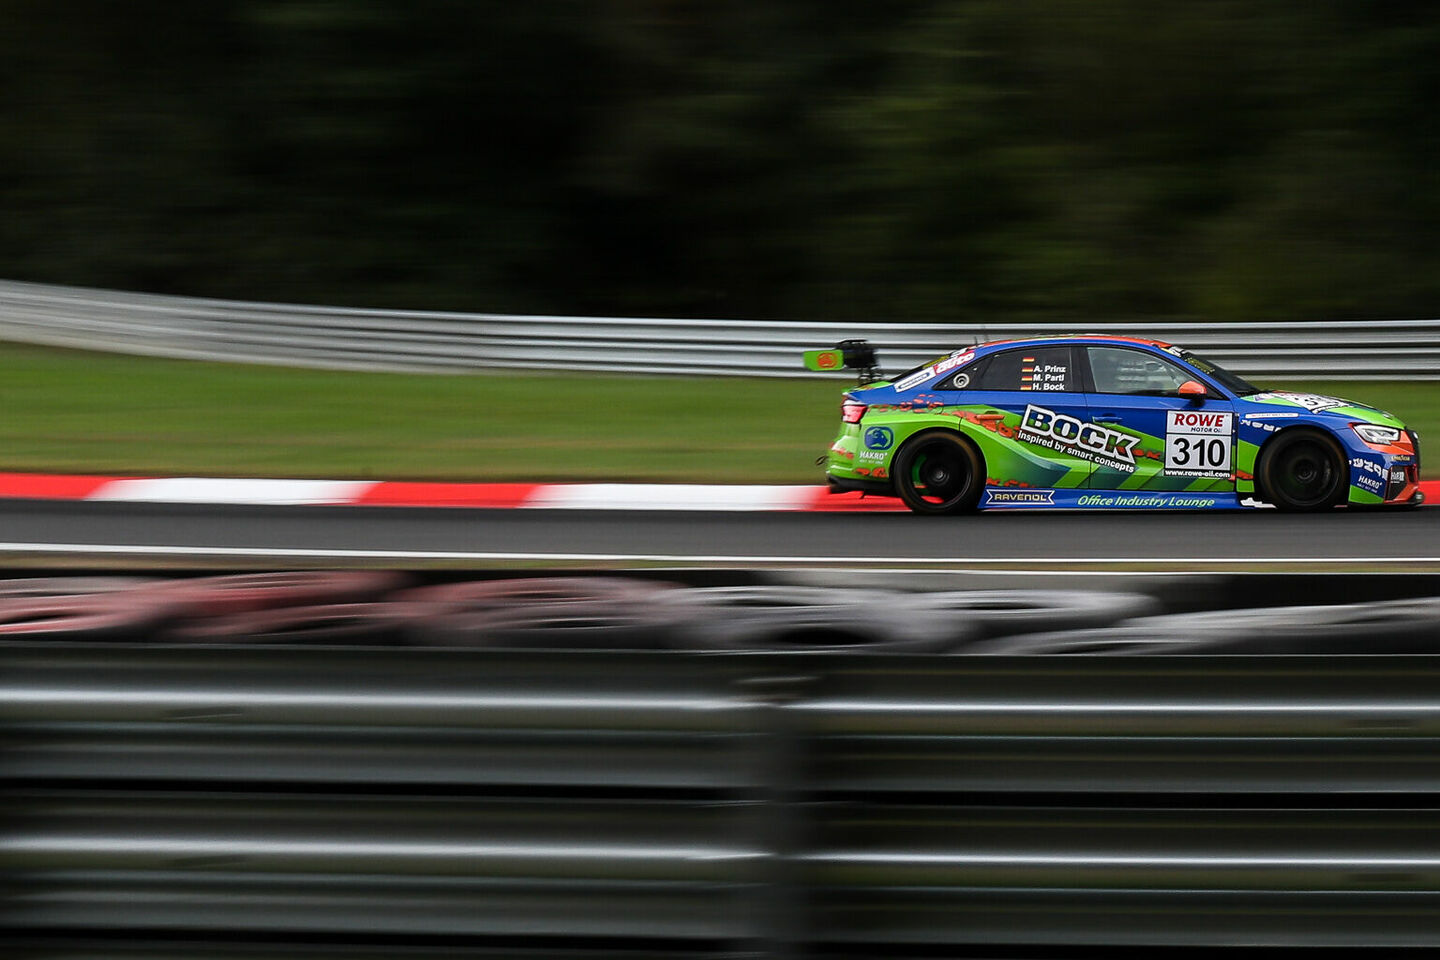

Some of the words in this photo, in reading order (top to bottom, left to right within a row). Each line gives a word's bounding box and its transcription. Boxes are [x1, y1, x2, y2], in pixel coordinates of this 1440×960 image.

[1033, 365, 1043, 373] A.
[1044, 365, 1067, 373] Prinz
[1174, 413, 1225, 427] ROWE
[1020, 404, 1141, 464] BOCK
[1018, 430, 1053, 448] inspired
[1054, 441, 1066, 453] by
[1067, 447, 1094, 461] smart
[1094, 455, 1135, 473] concepts
[1171, 437, 1226, 467] 310
[1165, 470, 1231, 478] www.rowe-oil.com
[994, 493, 1047, 501] RAVENOL
[1077, 495, 1113, 506] Office
[1114, 496, 1167, 507] Industry
[1168, 497, 1215, 507] Lounge
